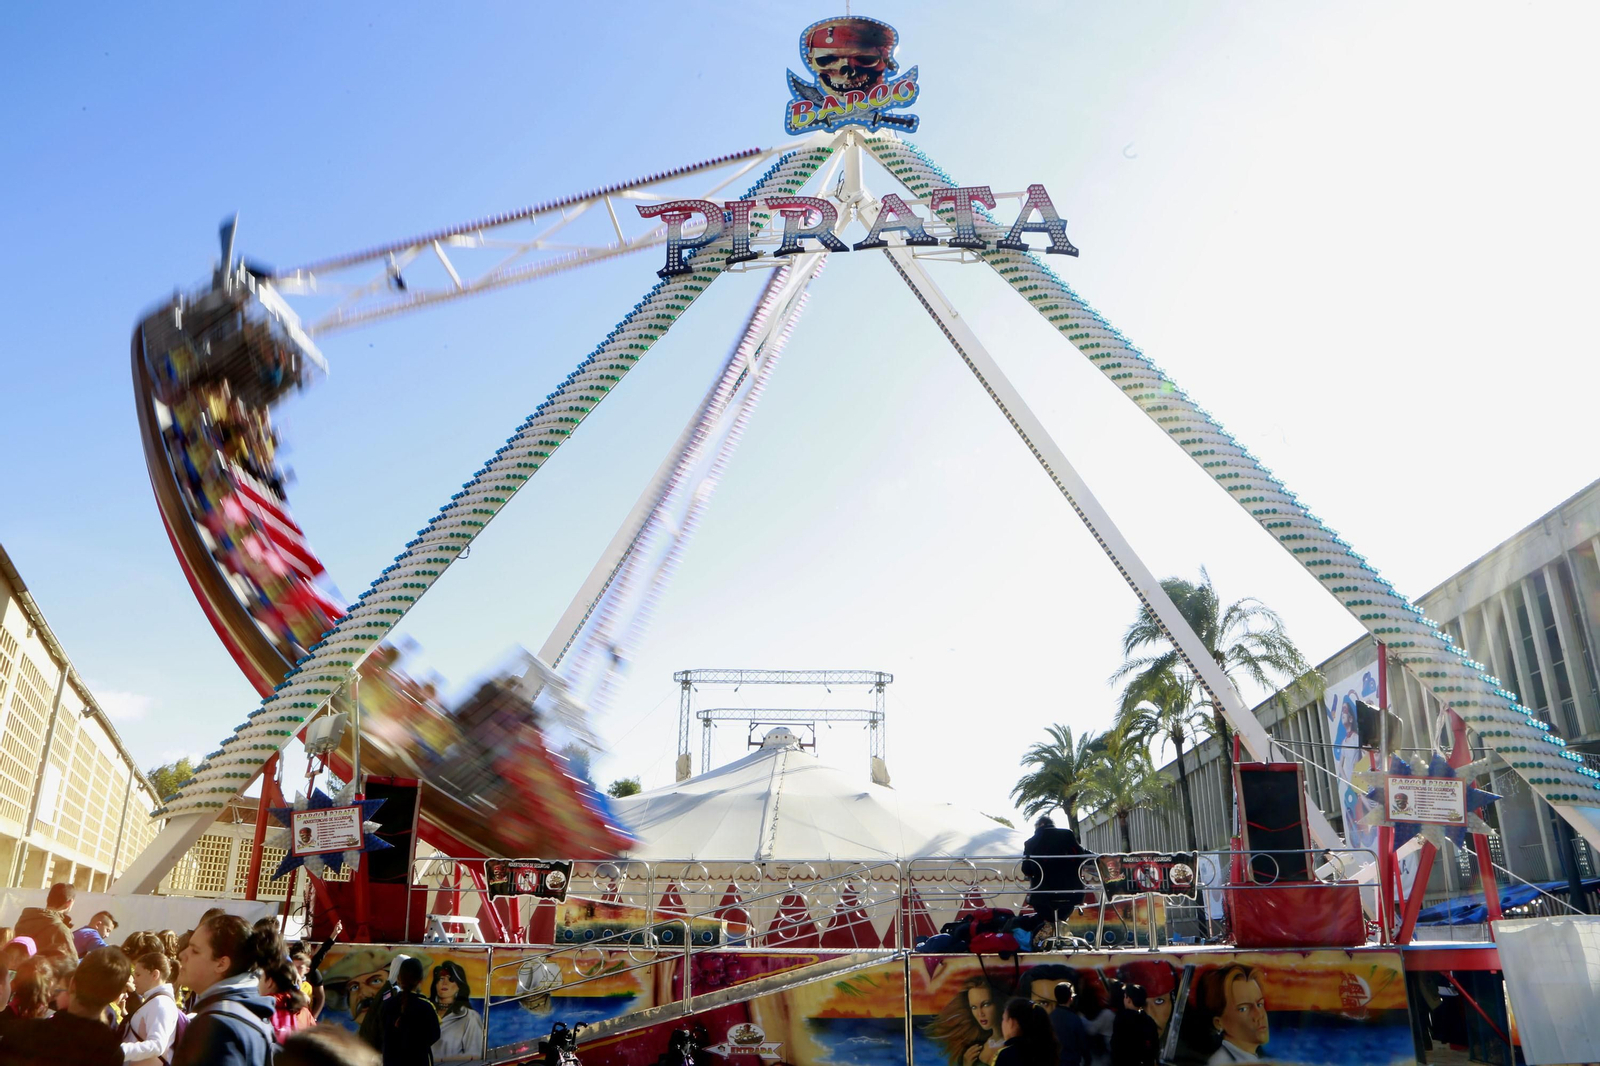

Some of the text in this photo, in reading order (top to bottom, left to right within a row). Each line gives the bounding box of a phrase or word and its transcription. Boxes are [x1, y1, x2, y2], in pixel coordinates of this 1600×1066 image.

[791, 79, 915, 127] BARCO
[635, 184, 1080, 278] PIRATA
[1391, 778, 1459, 788] BARCO PIRATA
[731, 1046, 773, 1054] ENTRADA
